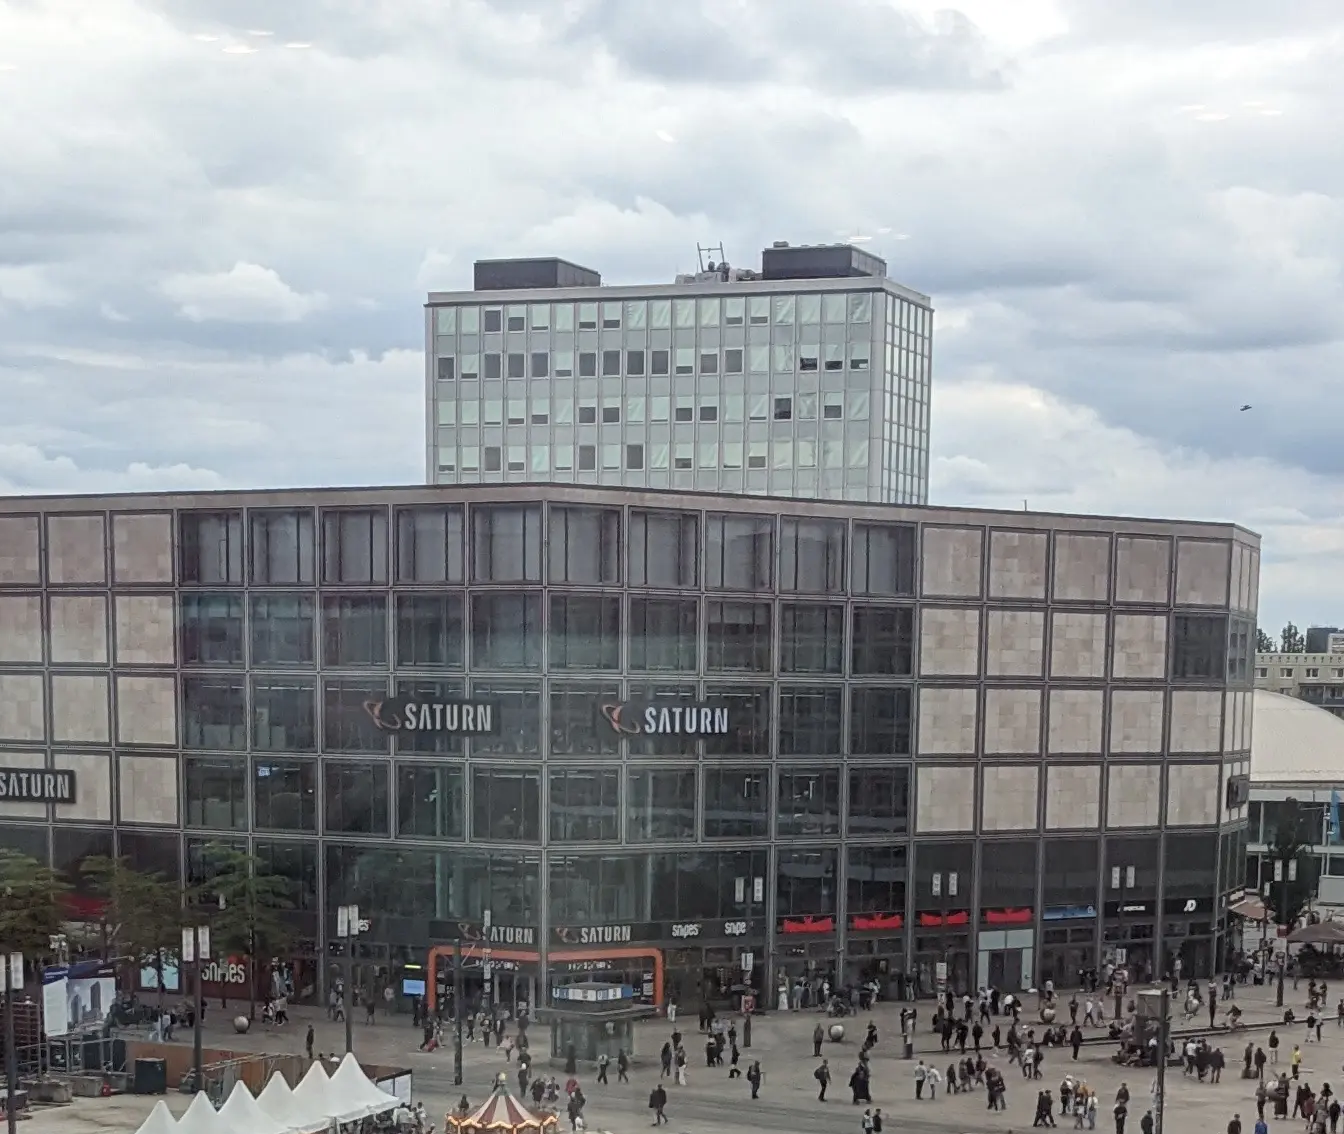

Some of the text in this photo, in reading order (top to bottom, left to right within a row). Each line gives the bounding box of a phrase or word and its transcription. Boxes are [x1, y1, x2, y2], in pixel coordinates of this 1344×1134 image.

[404, 702, 493, 732] SATURN
[643, 705, 729, 734] SATURN
[580, 925, 632, 944] SATURN
